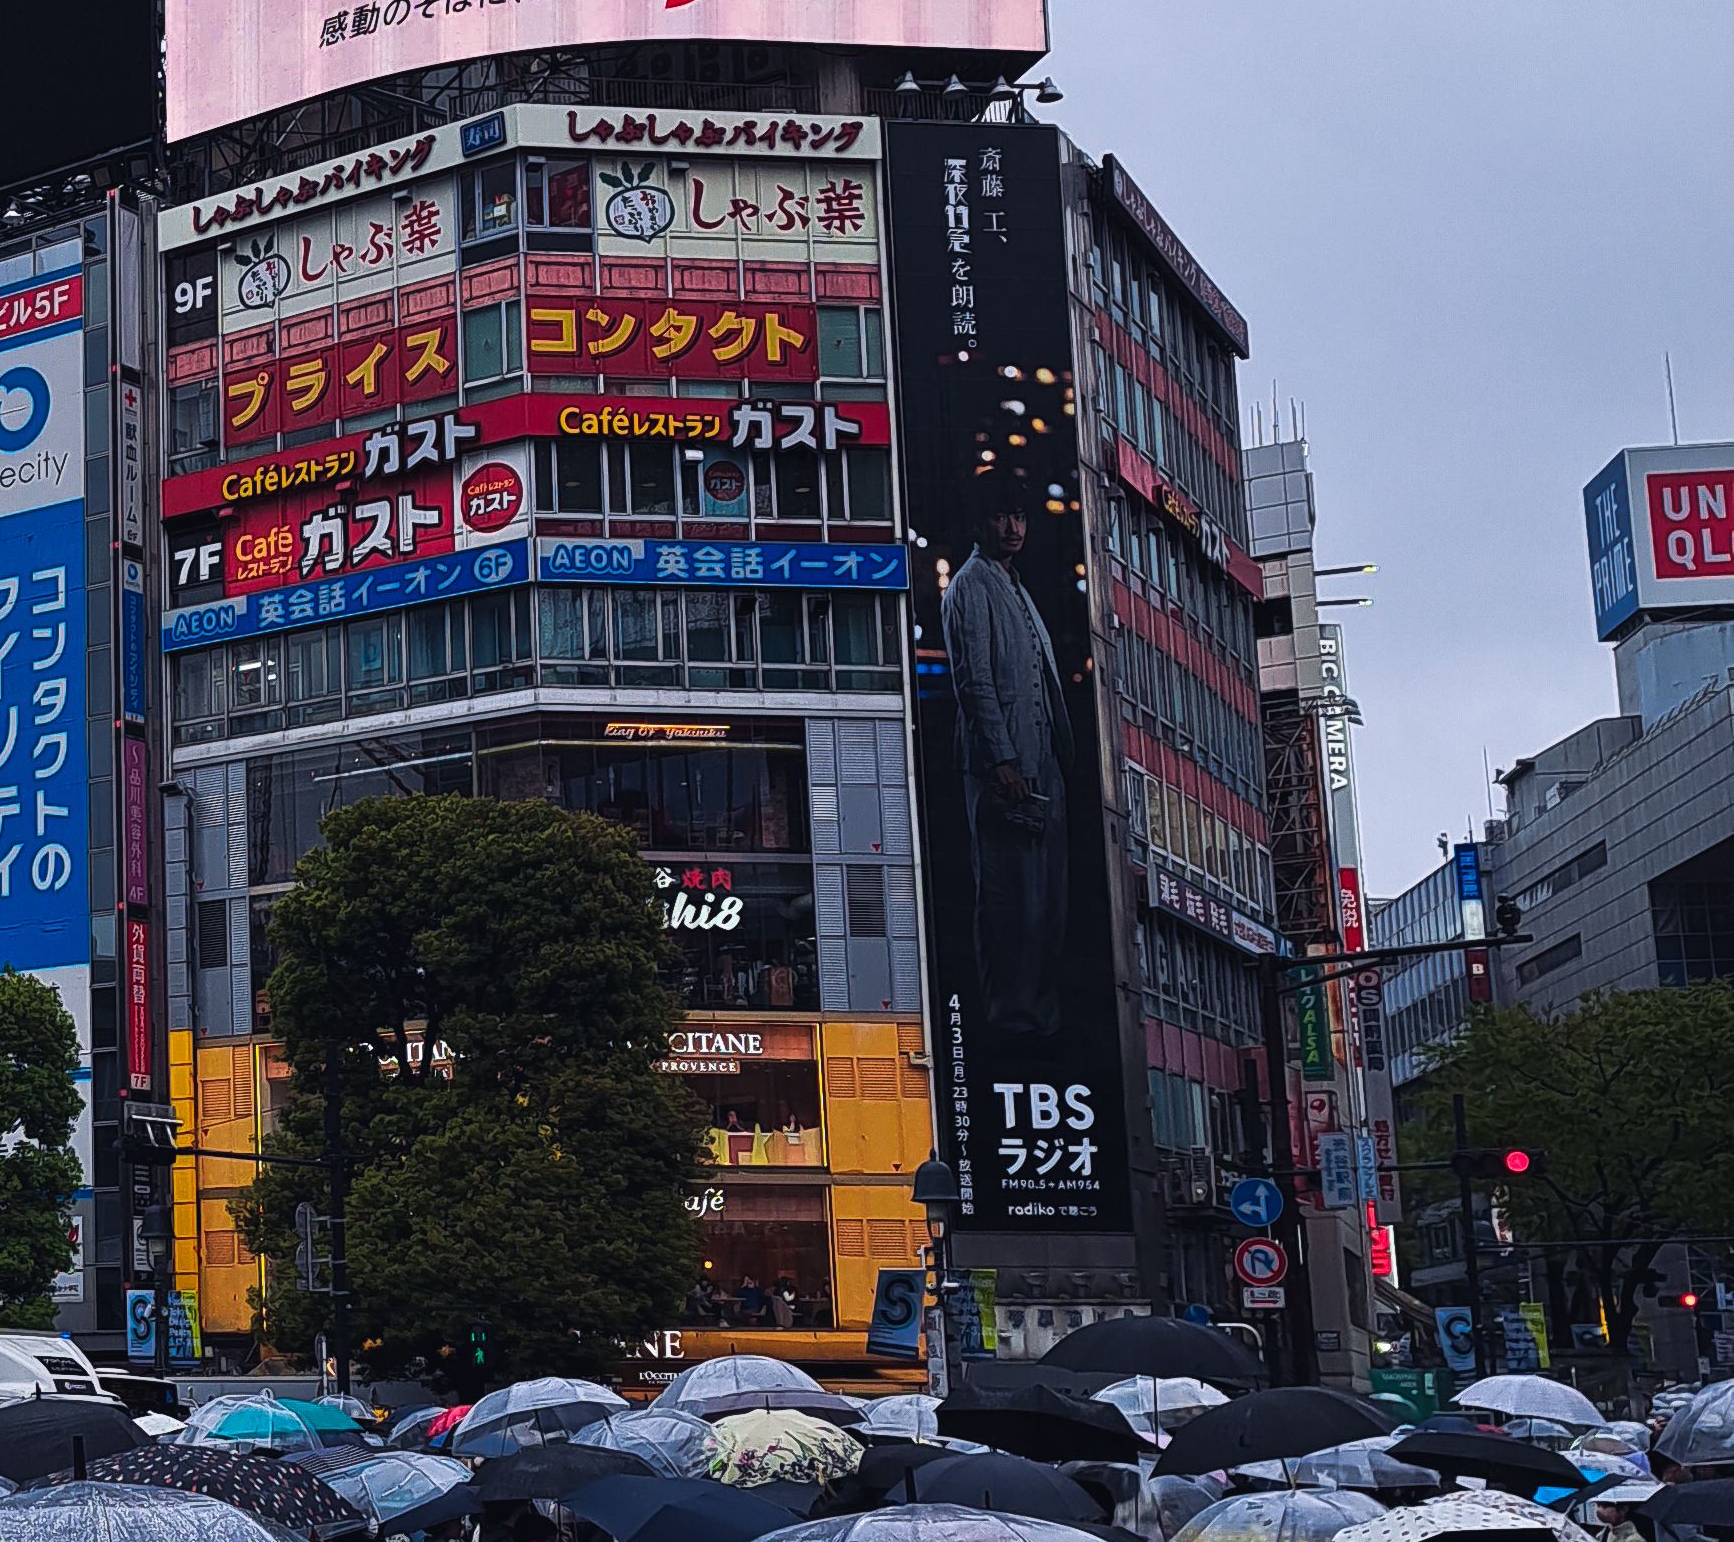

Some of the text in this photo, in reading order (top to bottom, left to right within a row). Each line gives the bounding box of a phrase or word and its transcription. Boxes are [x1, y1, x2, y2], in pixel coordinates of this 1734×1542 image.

[567, 111, 863, 152] しゃぶしゃぶバイキング
[192, 135, 437, 235] しゃぶしゃぶバイキング
[692, 178, 866, 236] しゃぶ葉
[300, 201, 442, 283] しゃぶ葉
[174, 276, 213, 313] 9F
[530, 308, 806, 361] コンタクト
[229, 328, 451, 427] プライス
[365, 414, 476, 478] ガスト
[732, 401, 860, 450] ガスト
[469, 493, 516, 517] ガスト
[1595, 483, 1621, 550] THE
[1662, 484, 1734, 521] UN
[235, 524, 293, 561] Café
[301, 495, 439, 574] ガスト
[1668, 528, 1734, 571] QL
[174, 543, 222, 585] 7F
[237, 556, 292, 580] レストラン
[554, 544, 898, 580] AEON 英会話イーオン
[1593, 536, 1634, 617] PRIME
[174, 607, 237, 640] AEON
[259, 564, 461, 627] 英会話イーオン
[1319, 639, 1340, 681] BIC
[32, 565, 72, 892] コンタクトの
[652, 867, 732, 891] 谷 焼肉
[667, 1032, 764, 1054] CITANE
[134, 1075, 147, 1088] 7F
[661, 1060, 737, 1072] PROVENCE
[993, 1083, 1095, 1130] TBS
[998, 1137, 1098, 1176] ラジオ
[681, 1187, 725, 1218] afé
[1008, 1202, 1055, 1216] radiko
